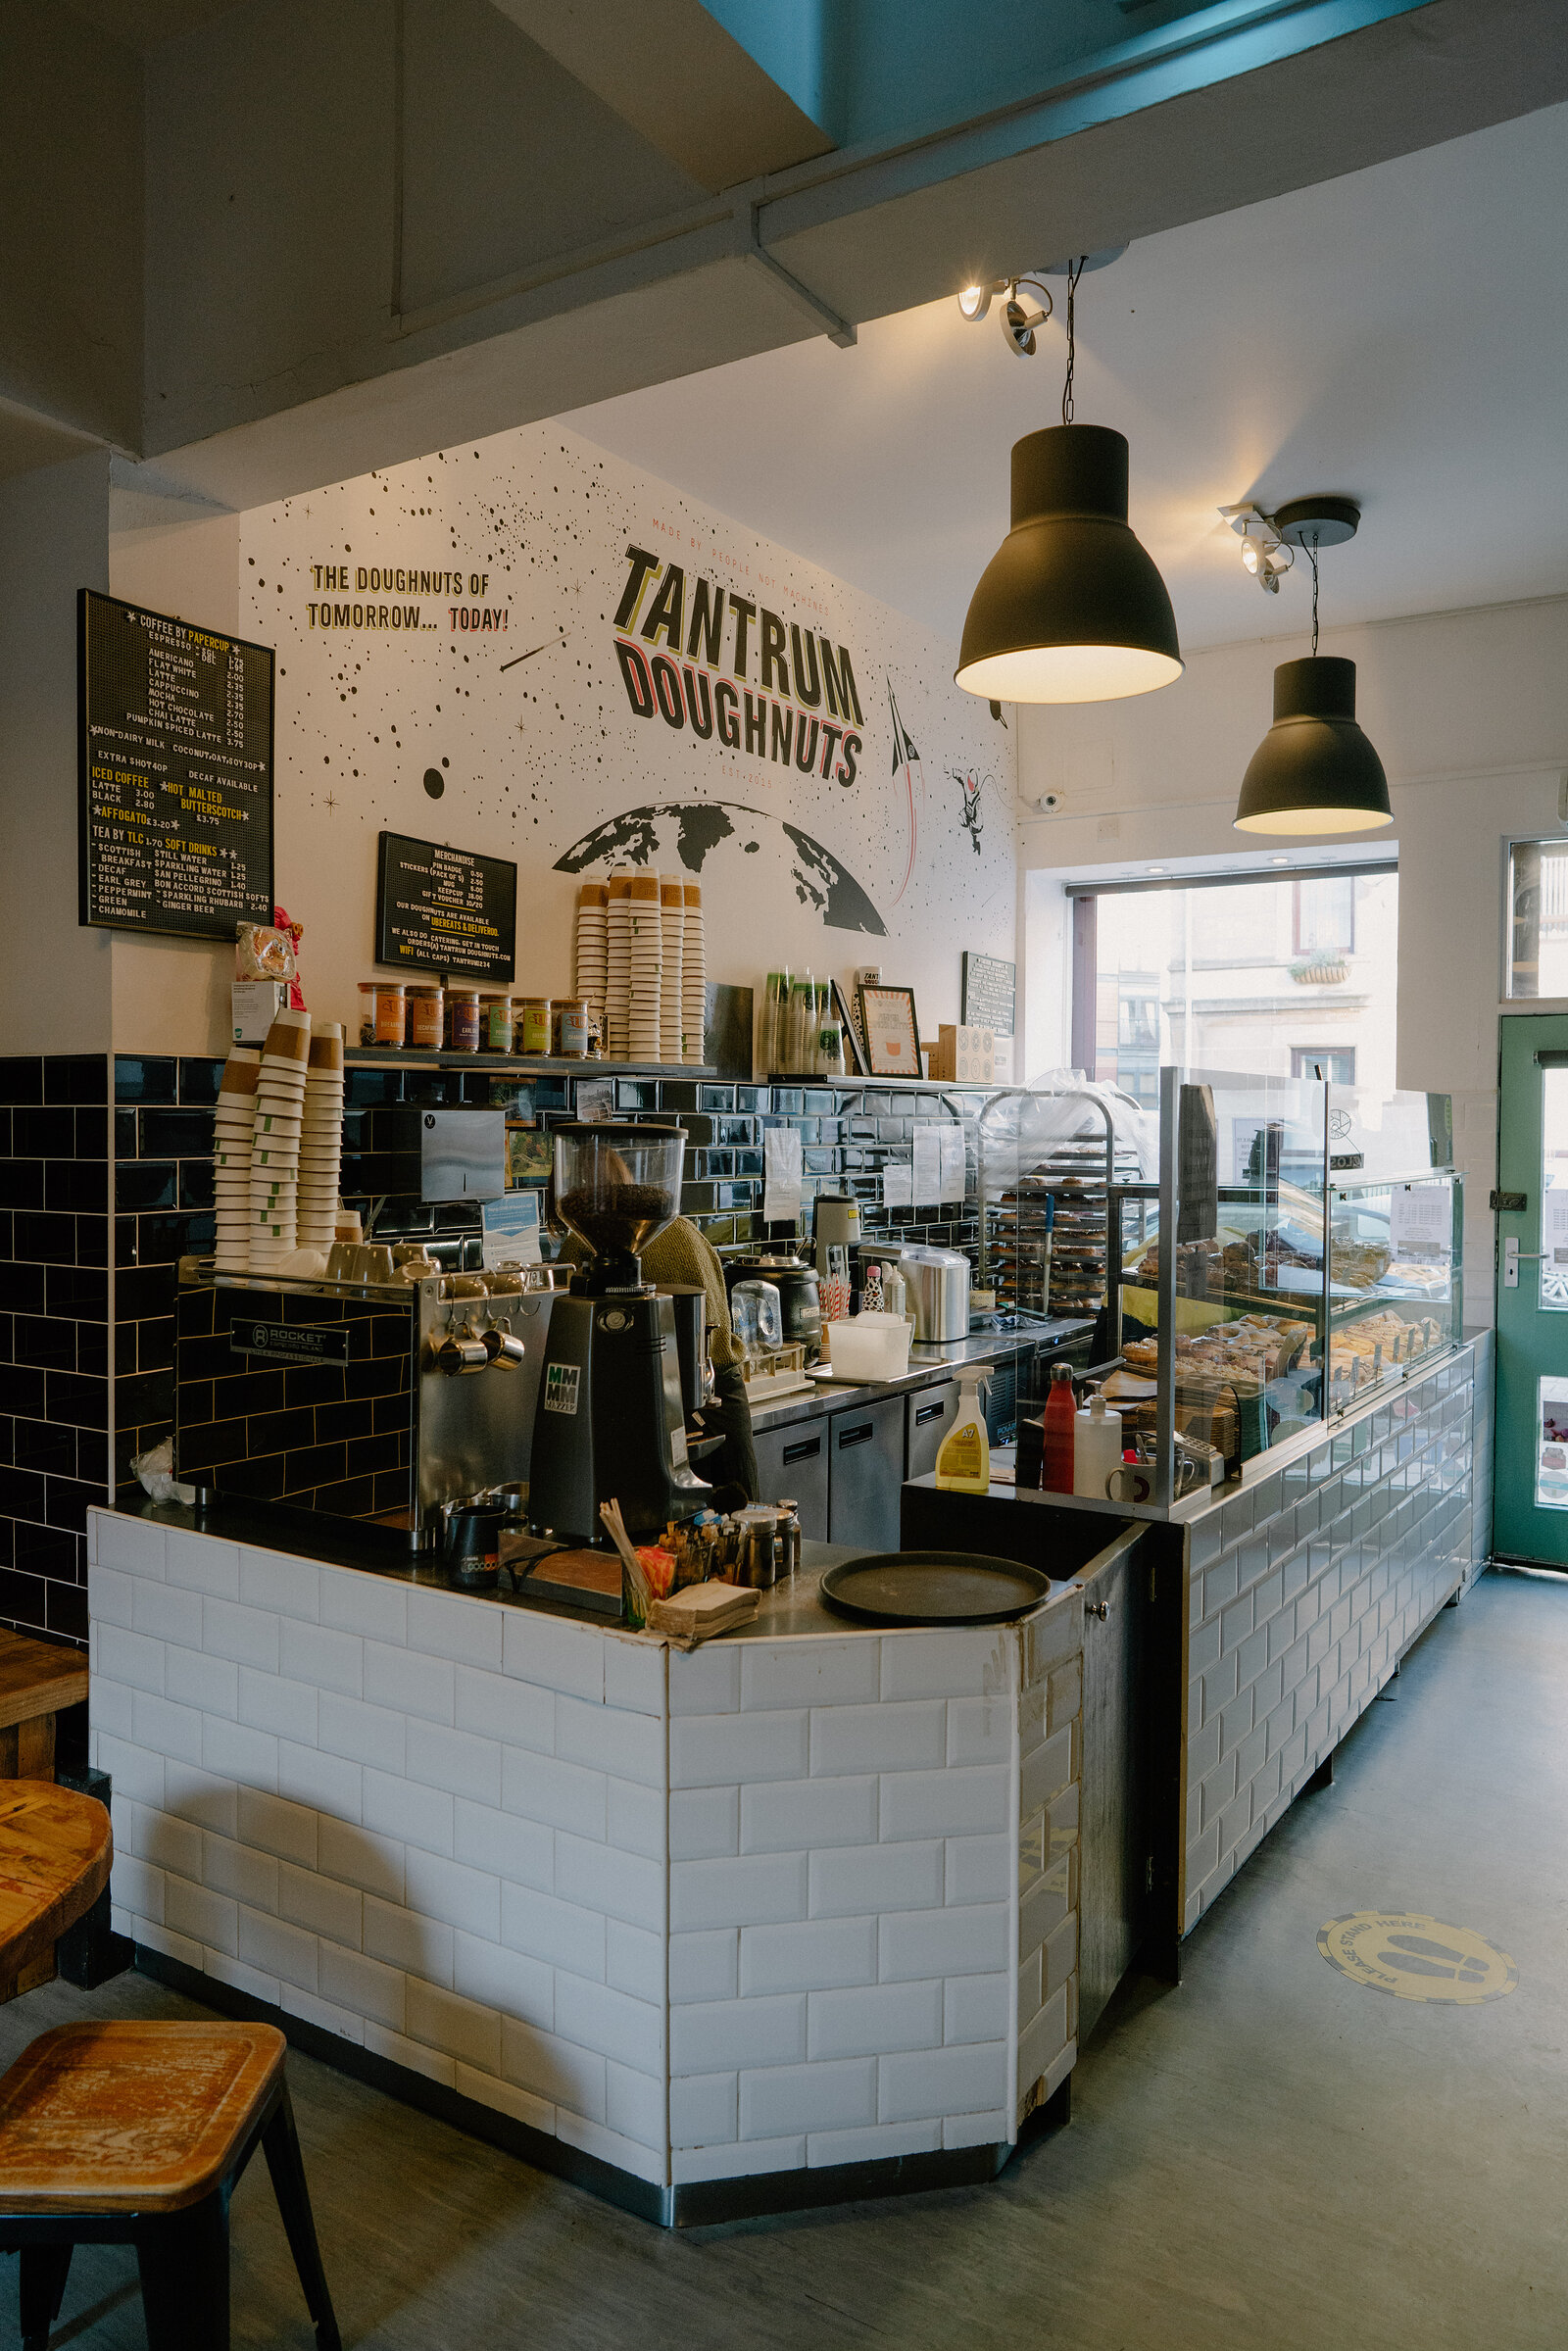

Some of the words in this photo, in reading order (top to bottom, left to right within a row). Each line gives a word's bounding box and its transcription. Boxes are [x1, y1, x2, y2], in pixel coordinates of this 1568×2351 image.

[653, 517, 680, 540] MADE
[690, 537, 702, 551] BY
[712, 549, 750, 575] PEOPLE
[759, 573, 776, 588] NOT
[783, 586, 829, 615] MACHINES
[312, 564, 350, 591] THE
[356, 566, 463, 596] DOUGHNUTS
[469, 573, 489, 598] OF
[307, 603, 437, 632] TOMORROW...
[449, 607, 509, 631] TODAY!
[140, 615, 172, 635] COFFEE
[175, 625, 186, 639] BY
[189, 630, 229, 652] PAPERCUP
[612, 543, 864, 730] TANTRUM
[149, 631, 191, 651] ESPRESSO
[202, 648, 216, 659] SGL
[228, 657, 243, 666] 1.75
[149, 649, 193, 667] AMERICANO
[227, 672, 243, 682] 2.00
[149, 659, 170, 670] FLAT
[172, 664, 196, 678] WHITE
[227, 682, 243, 692] 2.35
[149, 668, 175, 682] LATTE
[226, 691, 243, 701] 2.35
[149, 678, 199, 698] CAPPUCCINO
[227, 701, 243, 710] 2.35
[149, 688, 175, 702] MOCHA
[227, 710, 243, 719] 2.70
[149, 699, 165, 709] HOT
[168, 704, 214, 722] CHOCOLATE
[226, 719, 243, 729] 2.50
[612, 637, 862, 788] DOUGHNUTS
[126, 712, 163, 728] PUMPKIN
[165, 722, 194, 736] SPICED
[196, 730, 221, 743] LATTE
[226, 738, 243, 749] 3.75
[149, 709, 168, 719] CHAI
[171, 713, 196, 727] LATTE
[226, 729, 243, 739] 2.50
[98, 726, 143, 744] NON-DAIRY
[146, 738, 165, 749] MILK
[98, 751, 126, 763] EXTRA
[92, 766, 113, 780] ICED
[115, 771, 149, 788] COFFEE
[189, 770, 214, 782] DECAF
[217, 777, 258, 792] AVAILABLE
[92, 780, 121, 793] LATTE
[136, 789, 154, 799] 3.00
[168, 782, 183, 796] HOT
[189, 787, 222, 804] MALTED
[92, 790, 121, 804] BLACK
[135, 800, 154, 809] 2.80
[102, 806, 147, 825] AFFOGATO
[146, 818, 171, 829] £3.20
[181, 799, 242, 820] BUTTERSCOTCH
[196, 814, 220, 825] £3.75
[92, 824, 110, 839] TEA
[113, 828, 124, 841] BY
[127, 831, 144, 845] TLC
[146, 838, 163, 848] 1.70
[98, 843, 141, 857] SCOTTISH
[155, 850, 178, 860] STILL
[180, 854, 207, 864] WATER
[166, 838, 186, 852] SOFT
[188, 842, 217, 857] DRINKS
[102, 855, 152, 869] BREAKFAST
[434, 850, 475, 867] MERCHANDISE
[444, 863, 462, 873] BADGE
[98, 864, 126, 875] DECAF
[155, 859, 199, 873] SPARKLING
[201, 867, 227, 878] WATER
[400, 861, 428, 873] STICKERS
[429, 867, 448, 879] (PACK
[99, 874, 121, 885] EARL
[124, 878, 146, 888] GREY
[155, 870, 171, 879] SAN
[173, 872, 221, 887] PELLEGRINO
[99, 885, 152, 899] PEPPERMINT
[99, 895, 127, 906] GREEN
[155, 879, 172, 889] BON
[173, 882, 204, 894] ACCORD
[207, 887, 244, 900] SCOTTISH
[245, 893, 270, 903] SOFTS
[163, 891, 207, 903] SPARKLING
[209, 897, 243, 908] RHUBARB
[437, 887, 464, 897] KEEPCUP
[437, 893, 464, 905] VOUCHER
[99, 906, 146, 918] CHAMOMILE
[163, 901, 191, 911] GINGER
[194, 905, 215, 914] BEER
[397, 901, 410, 909] OUR
[412, 904, 445, 917] DOUGHNUTS
[459, 913, 489, 925] AVAILABLE
[431, 916, 462, 930] UBEREATS
[463, 922, 467, 931] &
[400, 945, 414, 955] WIFI
[416, 949, 430, 958] (ALL
[432, 954, 450, 963] CAPS)
[440, 945, 466, 955] TANTRUM
[466, 949, 511, 961] DOUGHNUTS.COM
[481, 943, 500, 952] TOUCH
[270, 1330, 323, 1344] ROCKET
[962, 1429, 975, 1438] A7
[1340, 1923, 1373, 1946] STAND
[1374, 1921, 1426, 1931] HERE
[1342, 1948, 1397, 1984] PLEASE
